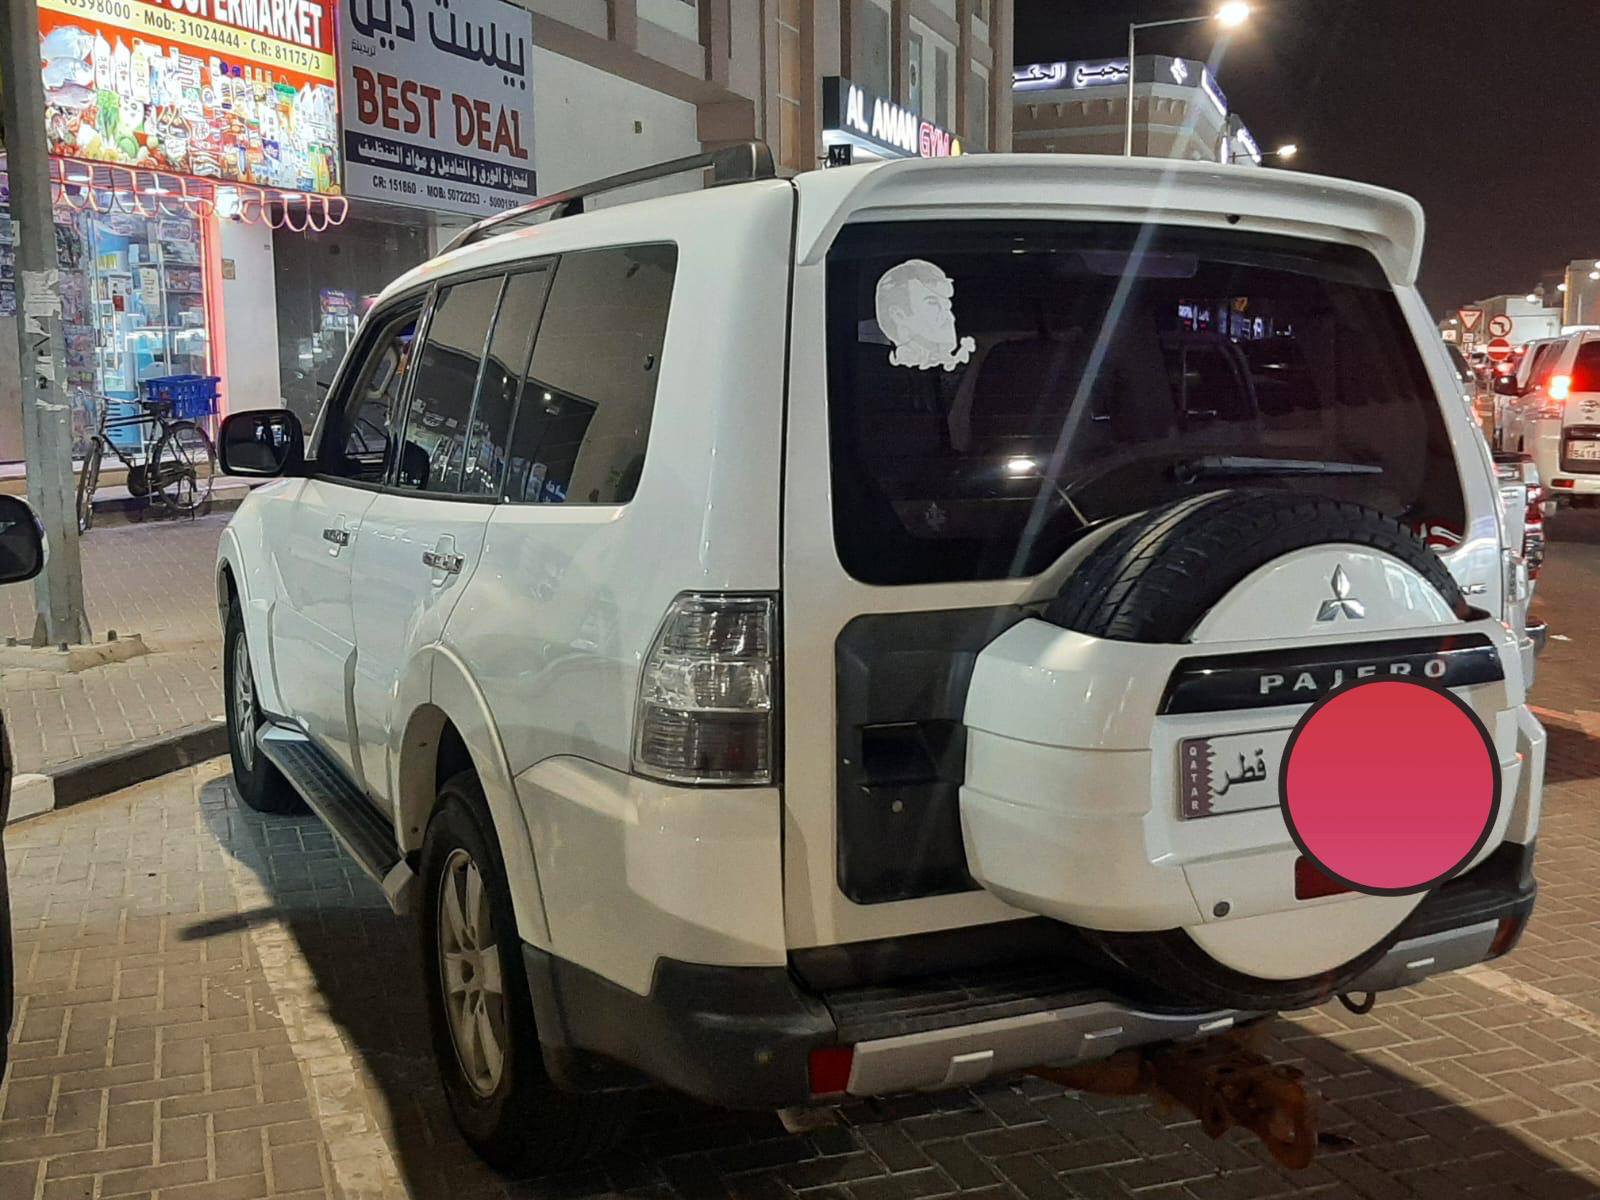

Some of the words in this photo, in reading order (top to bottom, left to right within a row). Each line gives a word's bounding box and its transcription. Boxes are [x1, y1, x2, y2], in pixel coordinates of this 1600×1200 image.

[63, 0, 130, 19] 398000
[144, 10, 176, 31] Mob:
[180, 19, 240, 48] 31024444
[251, 38, 272, 57] C.R:
[275, 45, 321, 71] 81175/3
[171, 0, 322, 49] ERMARKET
[429, 0, 526, 90] بيست
[352, 66, 442, 139] BEST
[452, 93, 528, 160] DEAL
[846, 83, 869, 133] AL
[872, 97, 918, 154] AMAN
[919, 121, 949, 158] GYM
[372, 175, 387, 189] CR:
[427, 185, 446, 199] MOB:
[1187, 745, 1199, 811] QATAR
[1213, 747, 1267, 796] قطر
